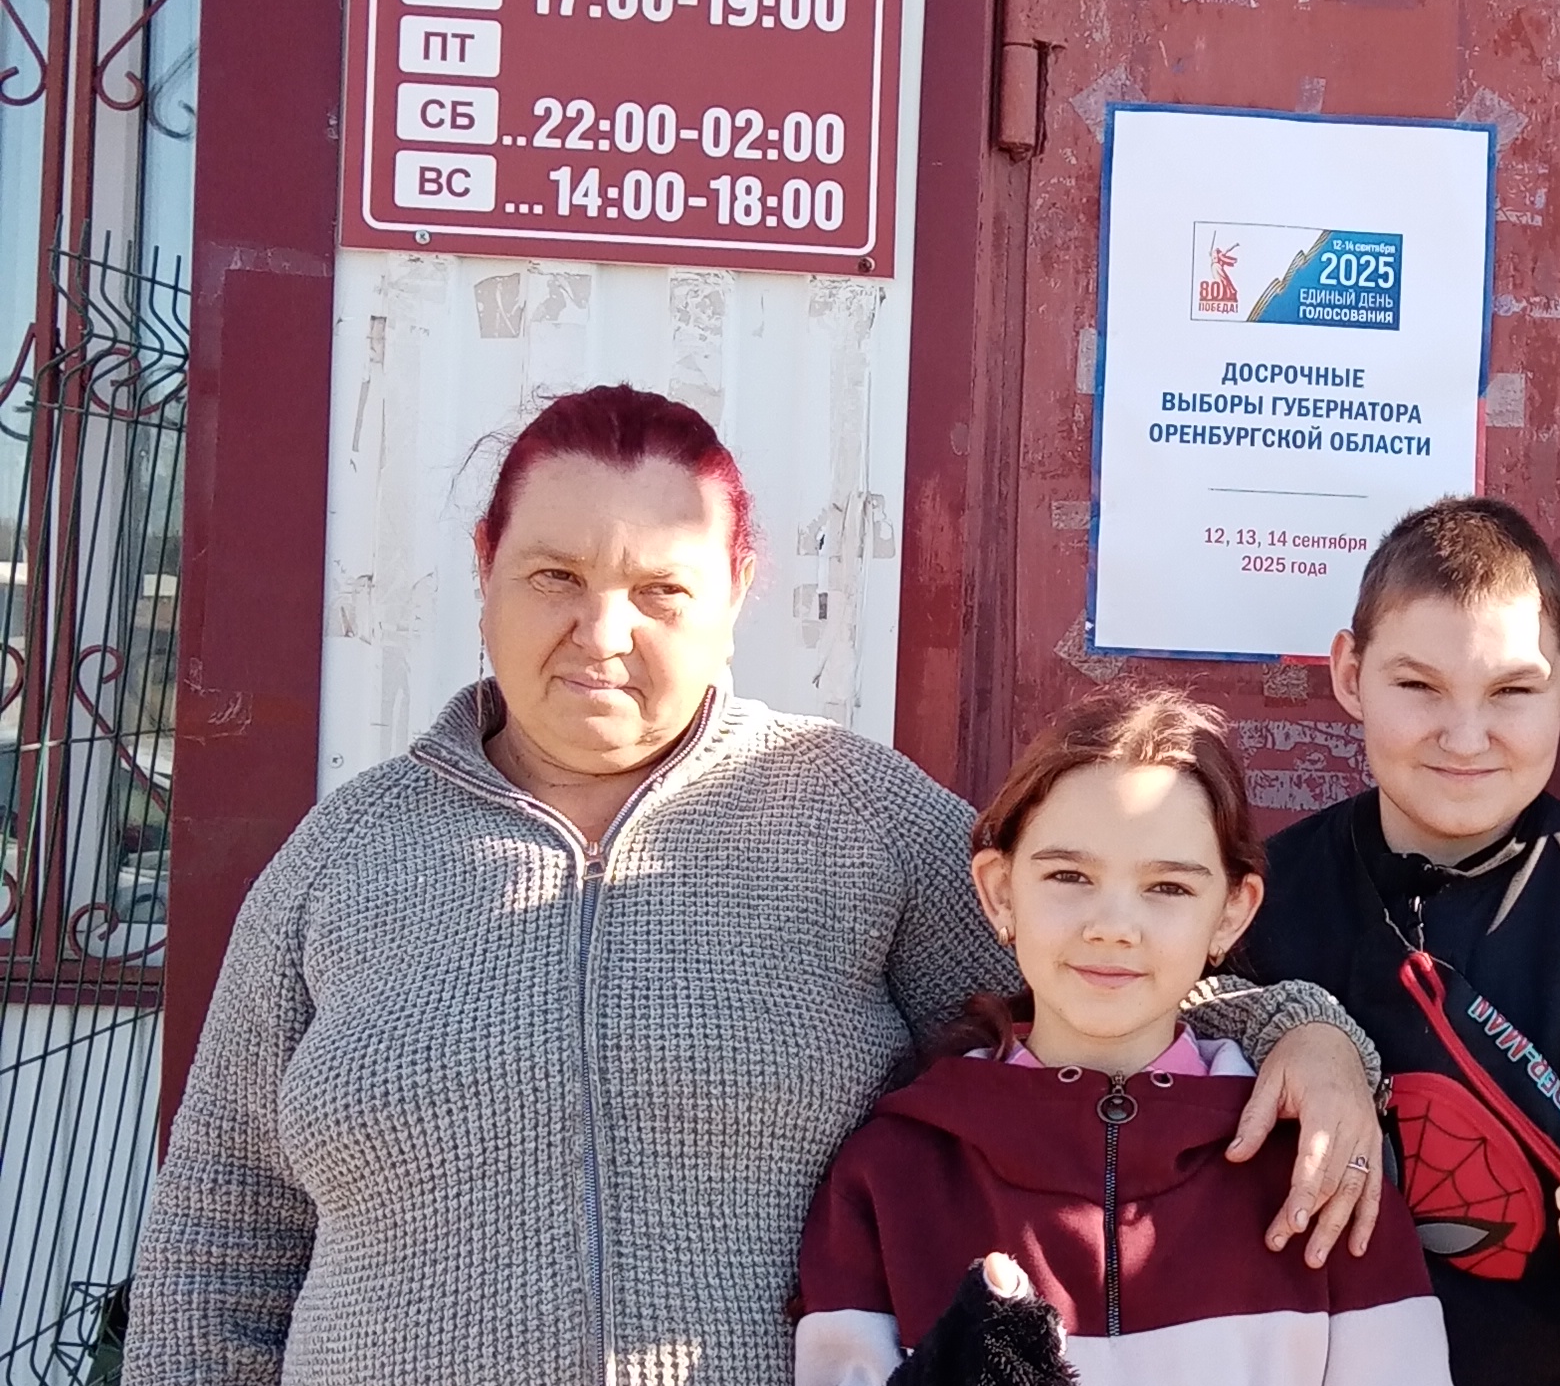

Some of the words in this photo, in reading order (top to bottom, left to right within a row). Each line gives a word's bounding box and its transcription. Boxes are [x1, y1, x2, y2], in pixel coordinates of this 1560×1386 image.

[423, 31, 474, 62] ПТ
[420, 100, 475, 130] СБ
[418, 166, 470, 198] ВС
[1333, 240, 1353, 250] 12-14
[1320, 253, 1394, 288] 2025
[1200, 281, 1223, 300] 80
[1300, 289, 1355, 305] ЕДИНЫЙ
[1358, 293, 1393, 307] ДЕНЬ
[1199, 302, 1238, 313] ПОБЕДА!
[1221, 362, 1365, 388] ДОСРОЧНЫЕ
[1162, 392, 1263, 415] ВЫБОРЫ
[1272, 397, 1421, 424] ГУБЕРНАТОРА
[1149, 423, 1322, 450] ОРЕНБУРГСКОЙ
[1330, 432, 1431, 456] ОБЛАСТИ
[1204, 527, 1231, 547] 12,
[1236, 528, 1262, 548] 13,
[1268, 530, 1288, 547] 14
[1293, 532, 1367, 553] сентября
[1241, 555, 1286, 574] 2025
[1291, 558, 1327, 577] года
